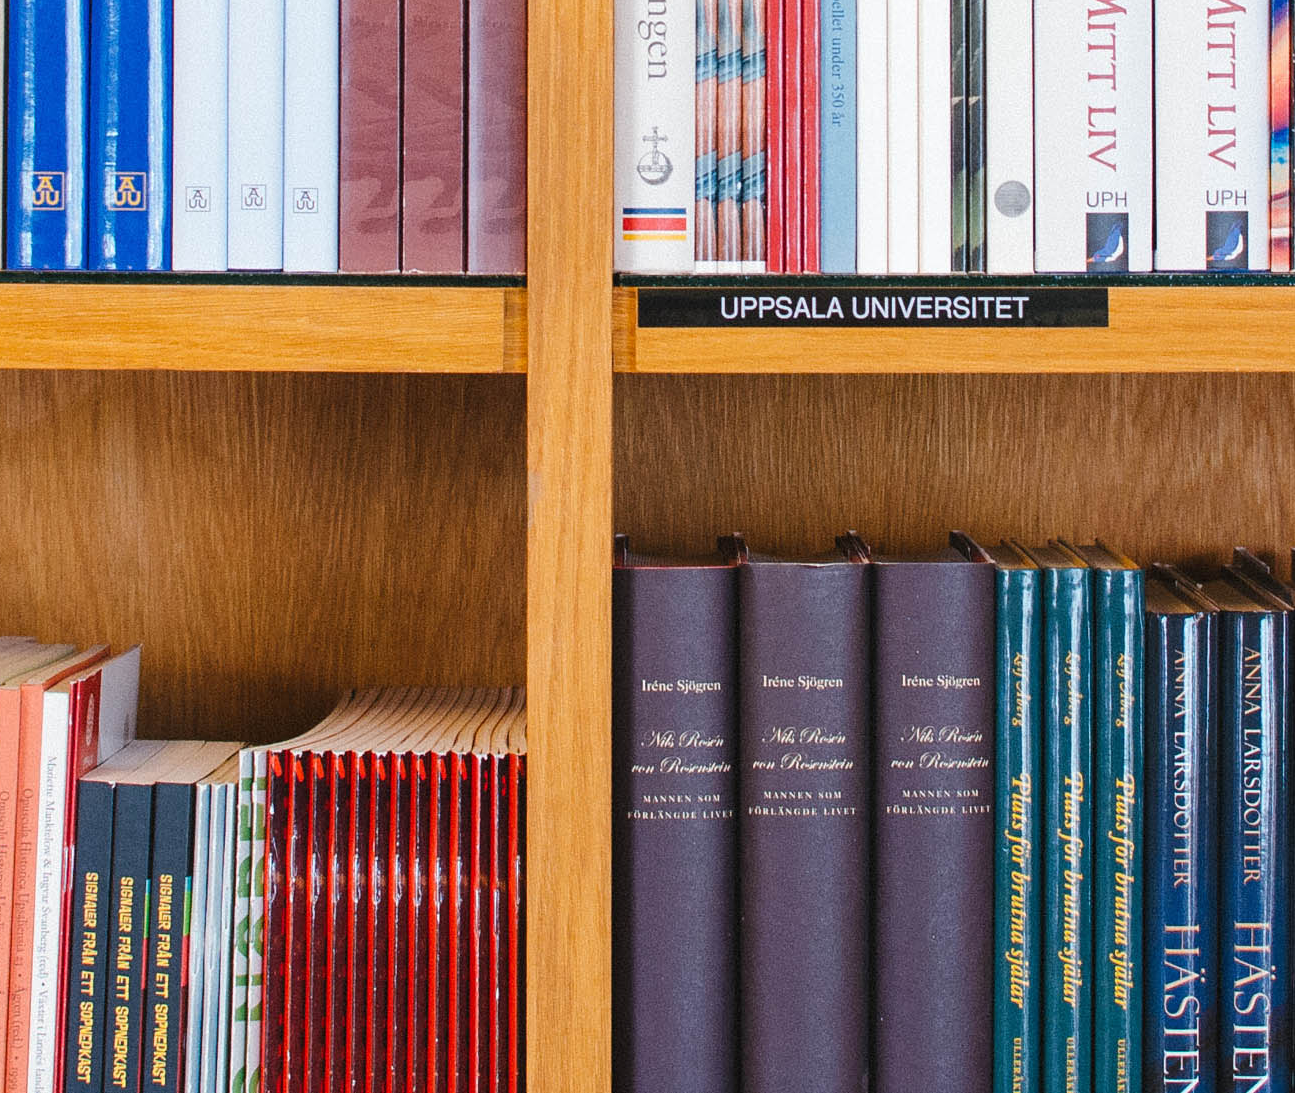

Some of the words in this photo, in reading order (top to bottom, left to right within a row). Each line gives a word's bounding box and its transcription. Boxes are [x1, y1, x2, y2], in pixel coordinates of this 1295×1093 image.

[831, 37, 843, 78] under
[831, 83, 843, 107] 350
[831, 111, 845, 126] år
[1207, 104, 1237, 170] LIV
[1206, 190, 1247, 206] UPH
[721, 296, 844, 319] UPPSALA
[852, 296, 1029, 319] UNIVERSITET
[763, 675, 794, 688] Iréne
[798, 675, 843, 690] Sjögren
[1243, 647, 1261, 714] ANNA
[1113, 772, 1135, 833] Plats
[1243, 729, 1262, 884] LARSDOTTER
[1110, 836, 1135, 867] för
[158, 875, 173, 929] SIGNALER
[1114, 872, 1134, 943] brutna
[156, 934, 173, 968] FRÅN
[156, 973, 168, 997] ETT
[1111, 950, 1134, 1008] själar
[152, 1004, 167, 1085] SOPNEDKAST
